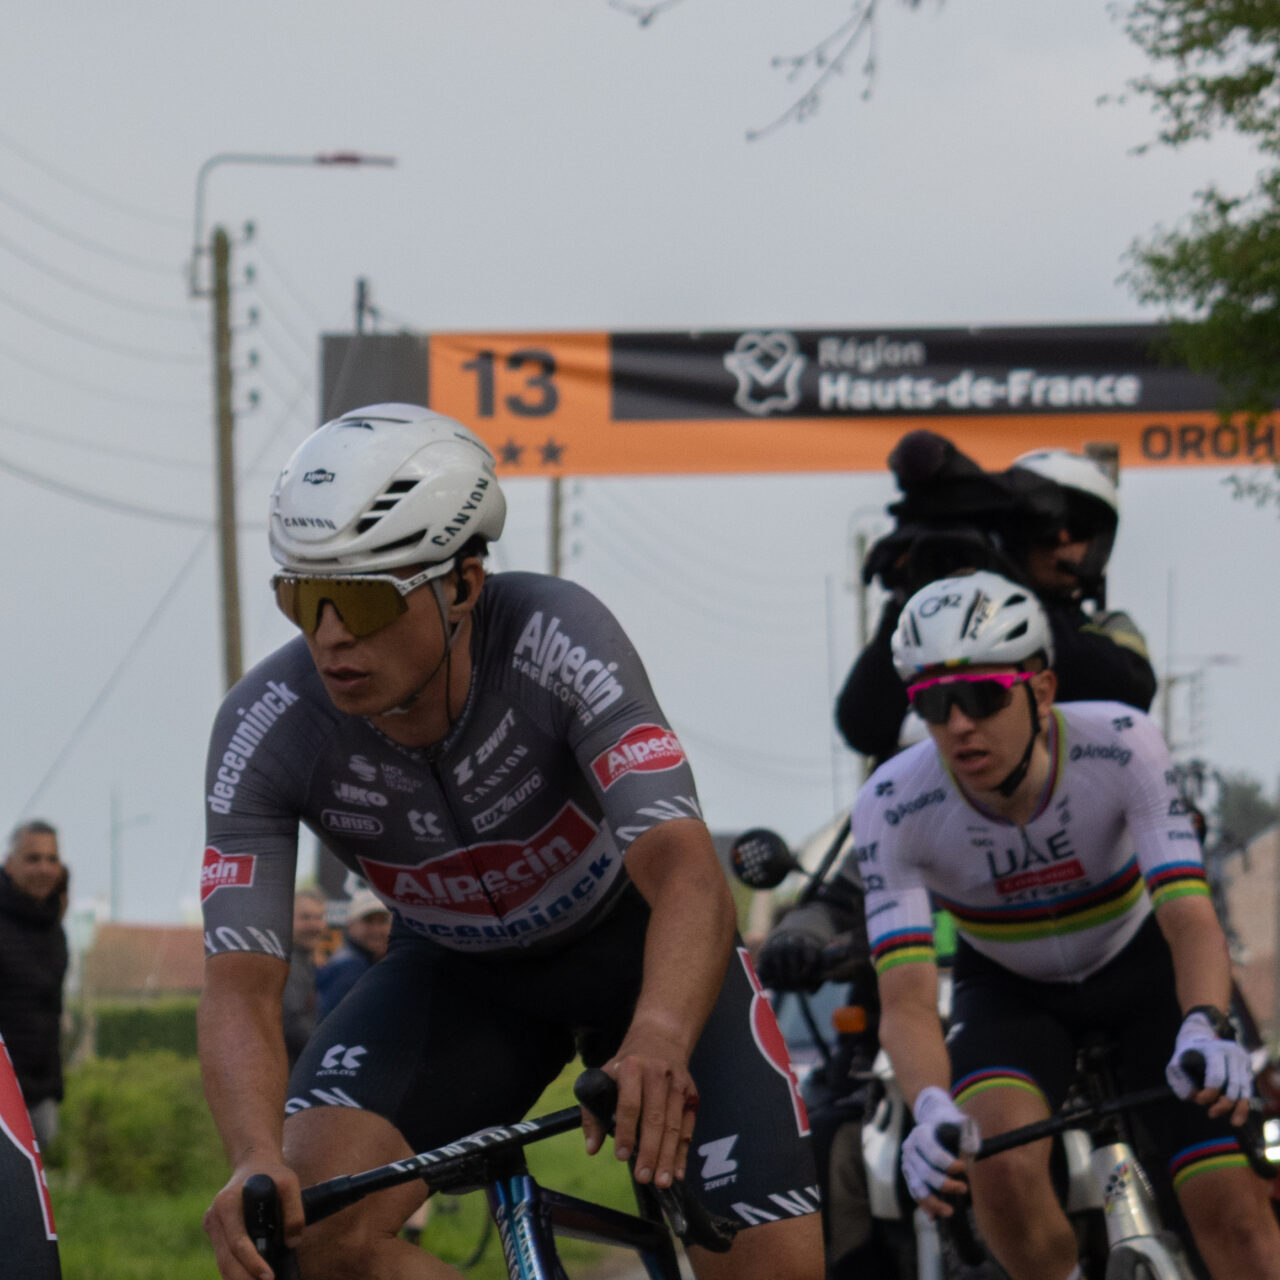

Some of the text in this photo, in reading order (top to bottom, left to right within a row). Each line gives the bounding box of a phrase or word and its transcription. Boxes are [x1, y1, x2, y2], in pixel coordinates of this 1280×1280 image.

[462, 347, 560, 419] 13
[819, 337, 925, 373] Région
[820, 369, 1141, 409] Hauts-de-France
[284, 516, 337, 531] CANYON
[431, 477, 489, 547] CANYON
[514, 611, 623, 716] Alpecin
[207, 680, 299, 815] deceuninck
[475, 708, 516, 765] ZWIFT
[463, 744, 528, 804] CANYON
[394, 835, 575, 904] Alpecin
[986, 829, 1076, 878] UAE
[704, 1173, 738, 1191] ZWIFT
